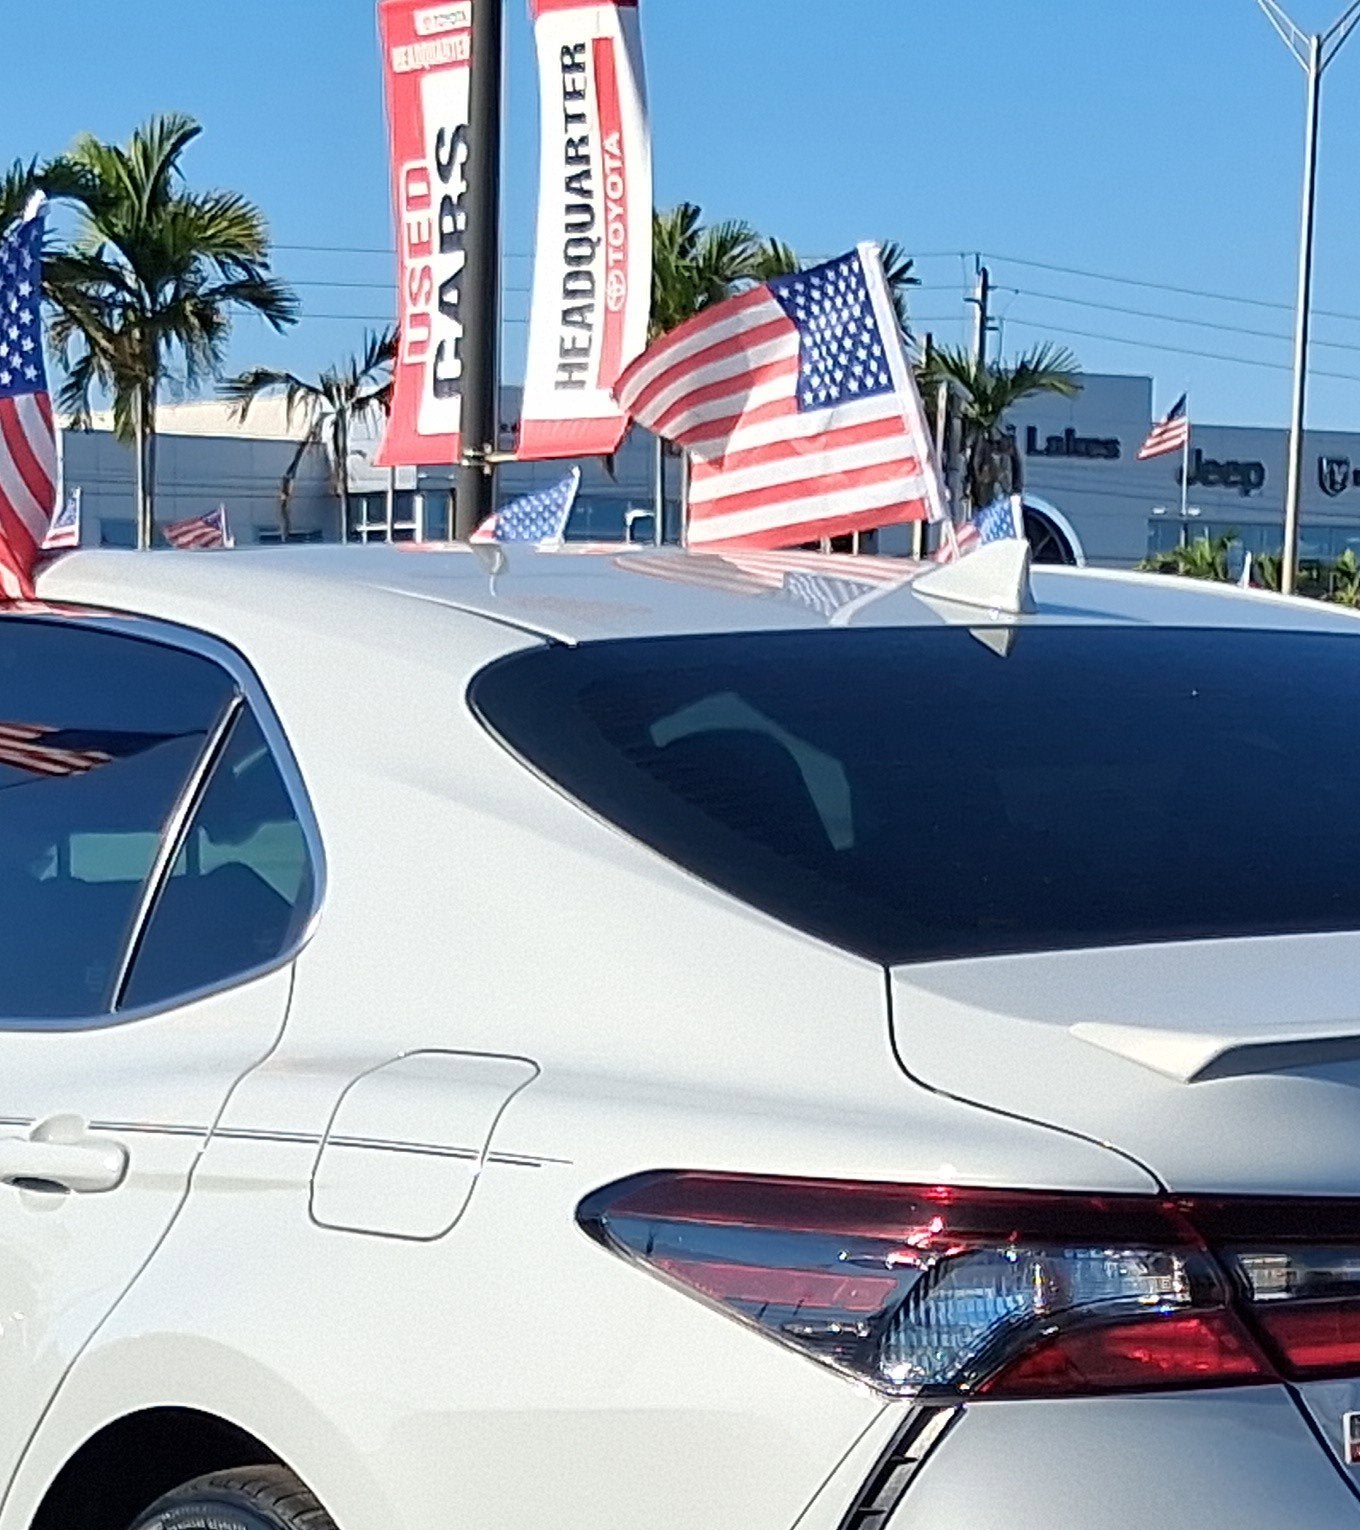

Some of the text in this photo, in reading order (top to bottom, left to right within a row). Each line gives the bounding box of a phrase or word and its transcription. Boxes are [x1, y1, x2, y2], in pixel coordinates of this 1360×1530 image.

[405, 165, 432, 358] USED
[433, 123, 469, 399] CARS
[554, 42, 601, 391] HEADQUARTER
[604, 131, 627, 268] TOYOTA
[1176, 447, 1266, 498] Jeep
